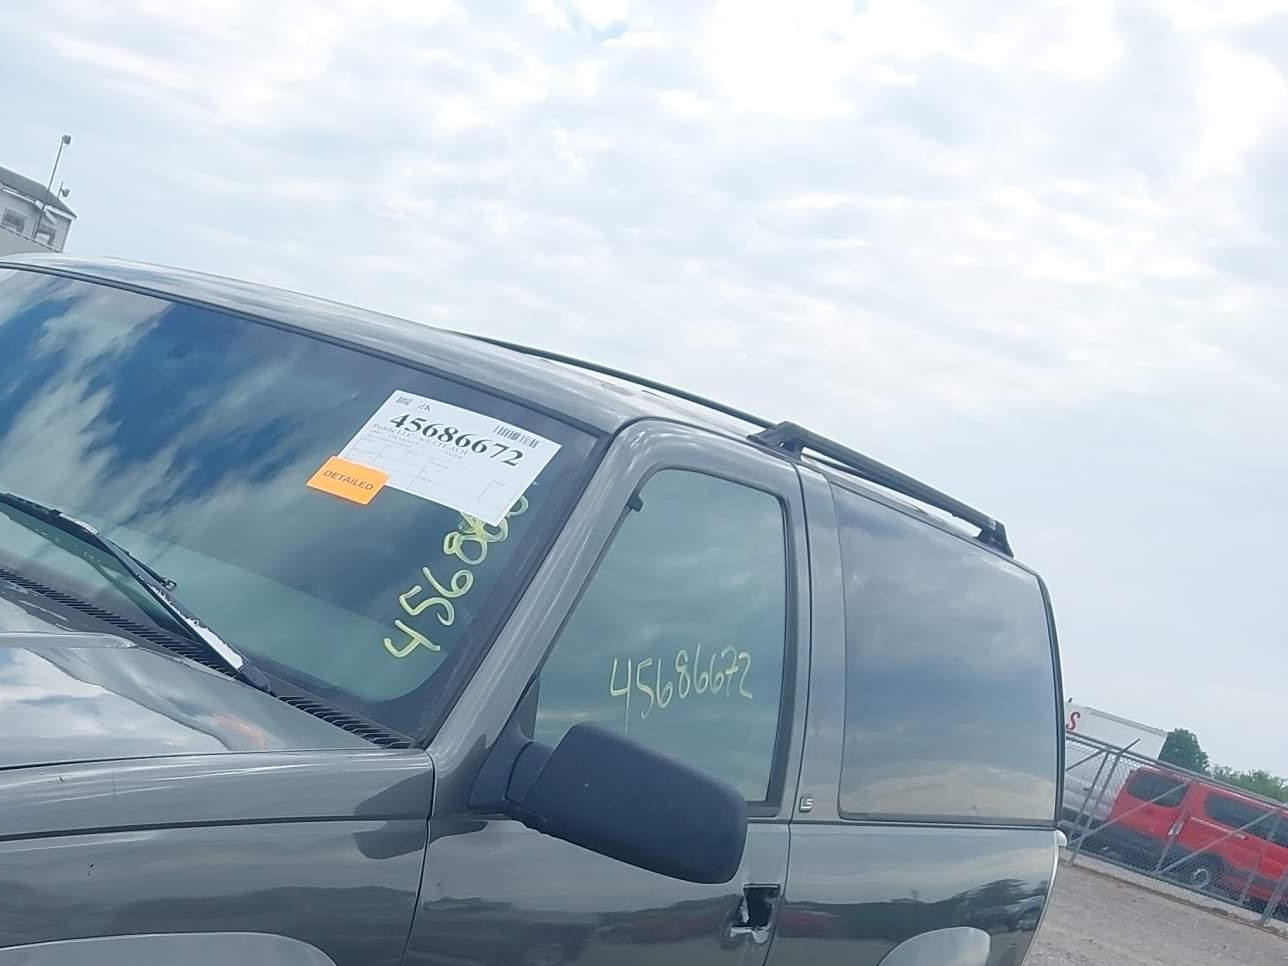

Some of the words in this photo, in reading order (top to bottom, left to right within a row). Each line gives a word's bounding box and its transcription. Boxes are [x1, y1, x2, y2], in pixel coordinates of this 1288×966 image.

[389, 412, 525, 467] 45686672
[323, 470, 374, 491] DETAILED
[610, 642, 753, 736] 45686672
